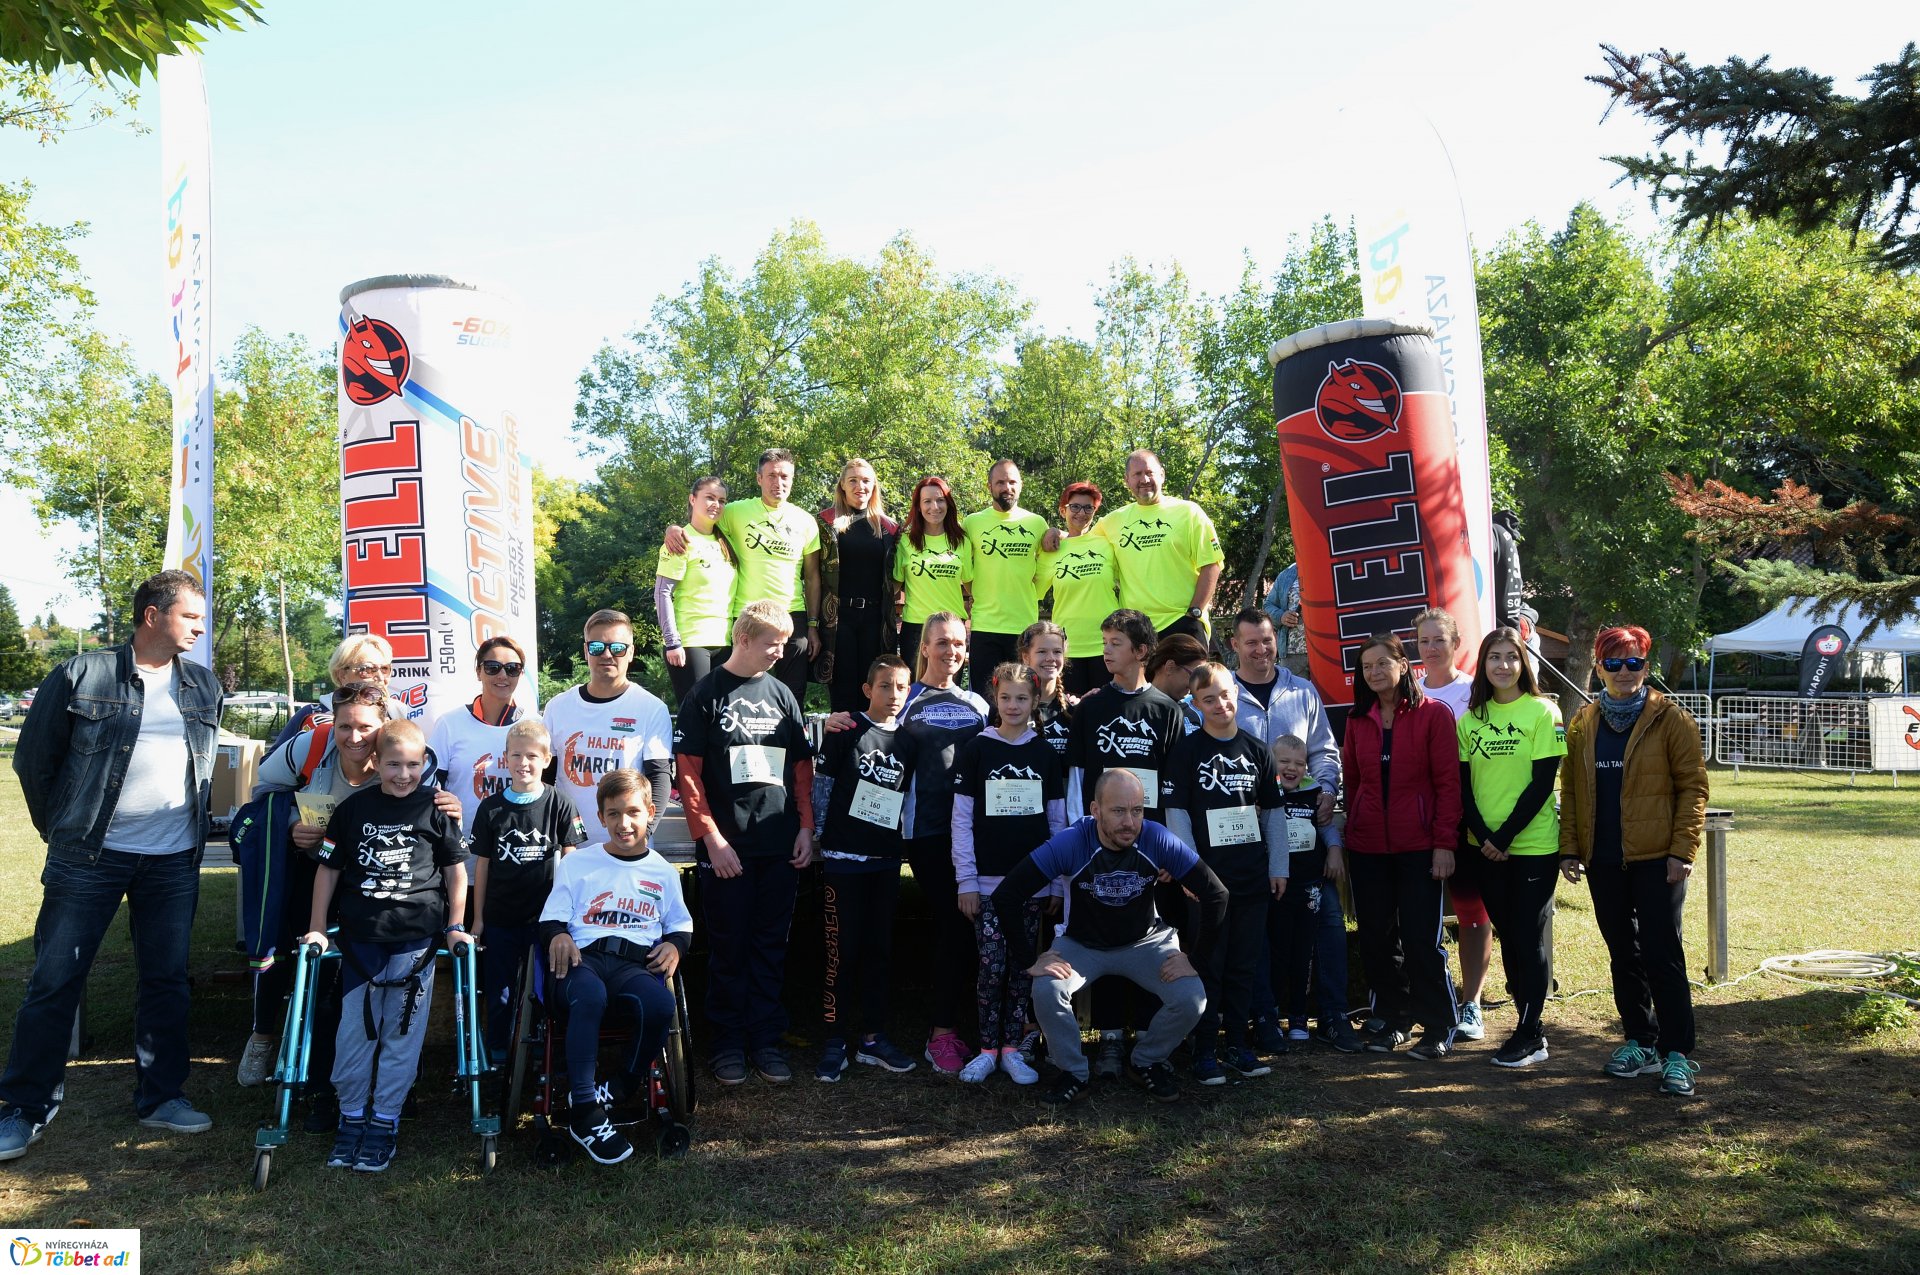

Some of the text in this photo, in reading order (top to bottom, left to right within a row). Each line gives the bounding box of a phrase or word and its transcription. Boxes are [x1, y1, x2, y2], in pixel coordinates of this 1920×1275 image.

[343, 420, 432, 663] HELL
[460, 416, 508, 653] ACTIVE
[508, 531, 519, 617] ENERGY
[516, 538, 525, 600] DRINK
[1322, 453, 1429, 673] HELL
[1807, 656, 1829, 697] MAPONT
[571, 755, 620, 773] MARCI
[588, 735, 626, 751] HAJRÁ
[870, 801, 881, 810] 160
[1231, 823, 1244, 831] 159
